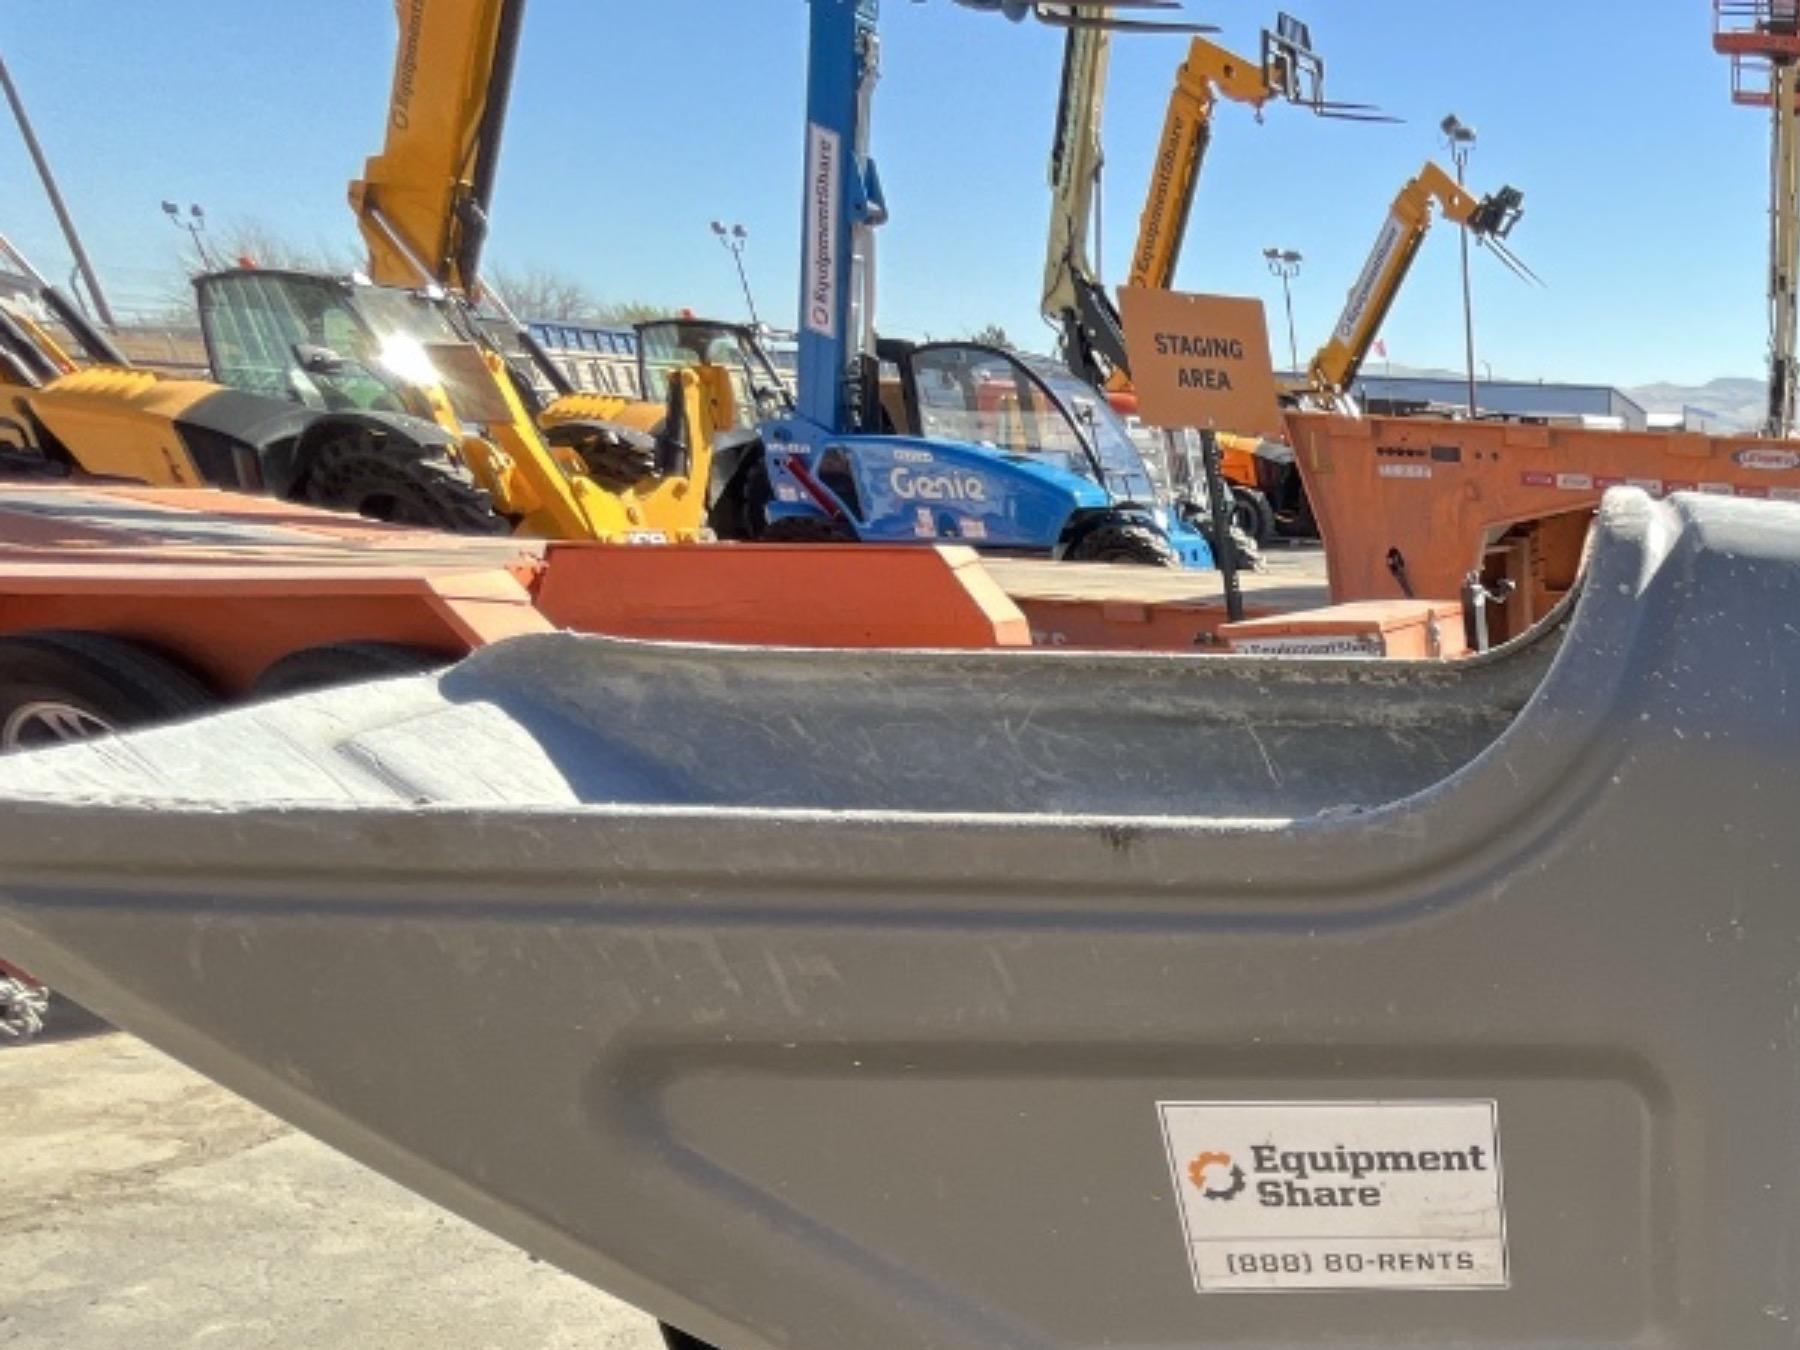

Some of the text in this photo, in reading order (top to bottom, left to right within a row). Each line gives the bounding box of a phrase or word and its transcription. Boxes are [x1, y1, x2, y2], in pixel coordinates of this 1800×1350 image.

[1154, 333, 1243, 360] STAGING
[1178, 368, 1234, 391] AREA
[890, 467, 985, 501] Genie
[1250, 1144, 1487, 1179] Equipment
[1256, 1181, 1382, 1208] Share
